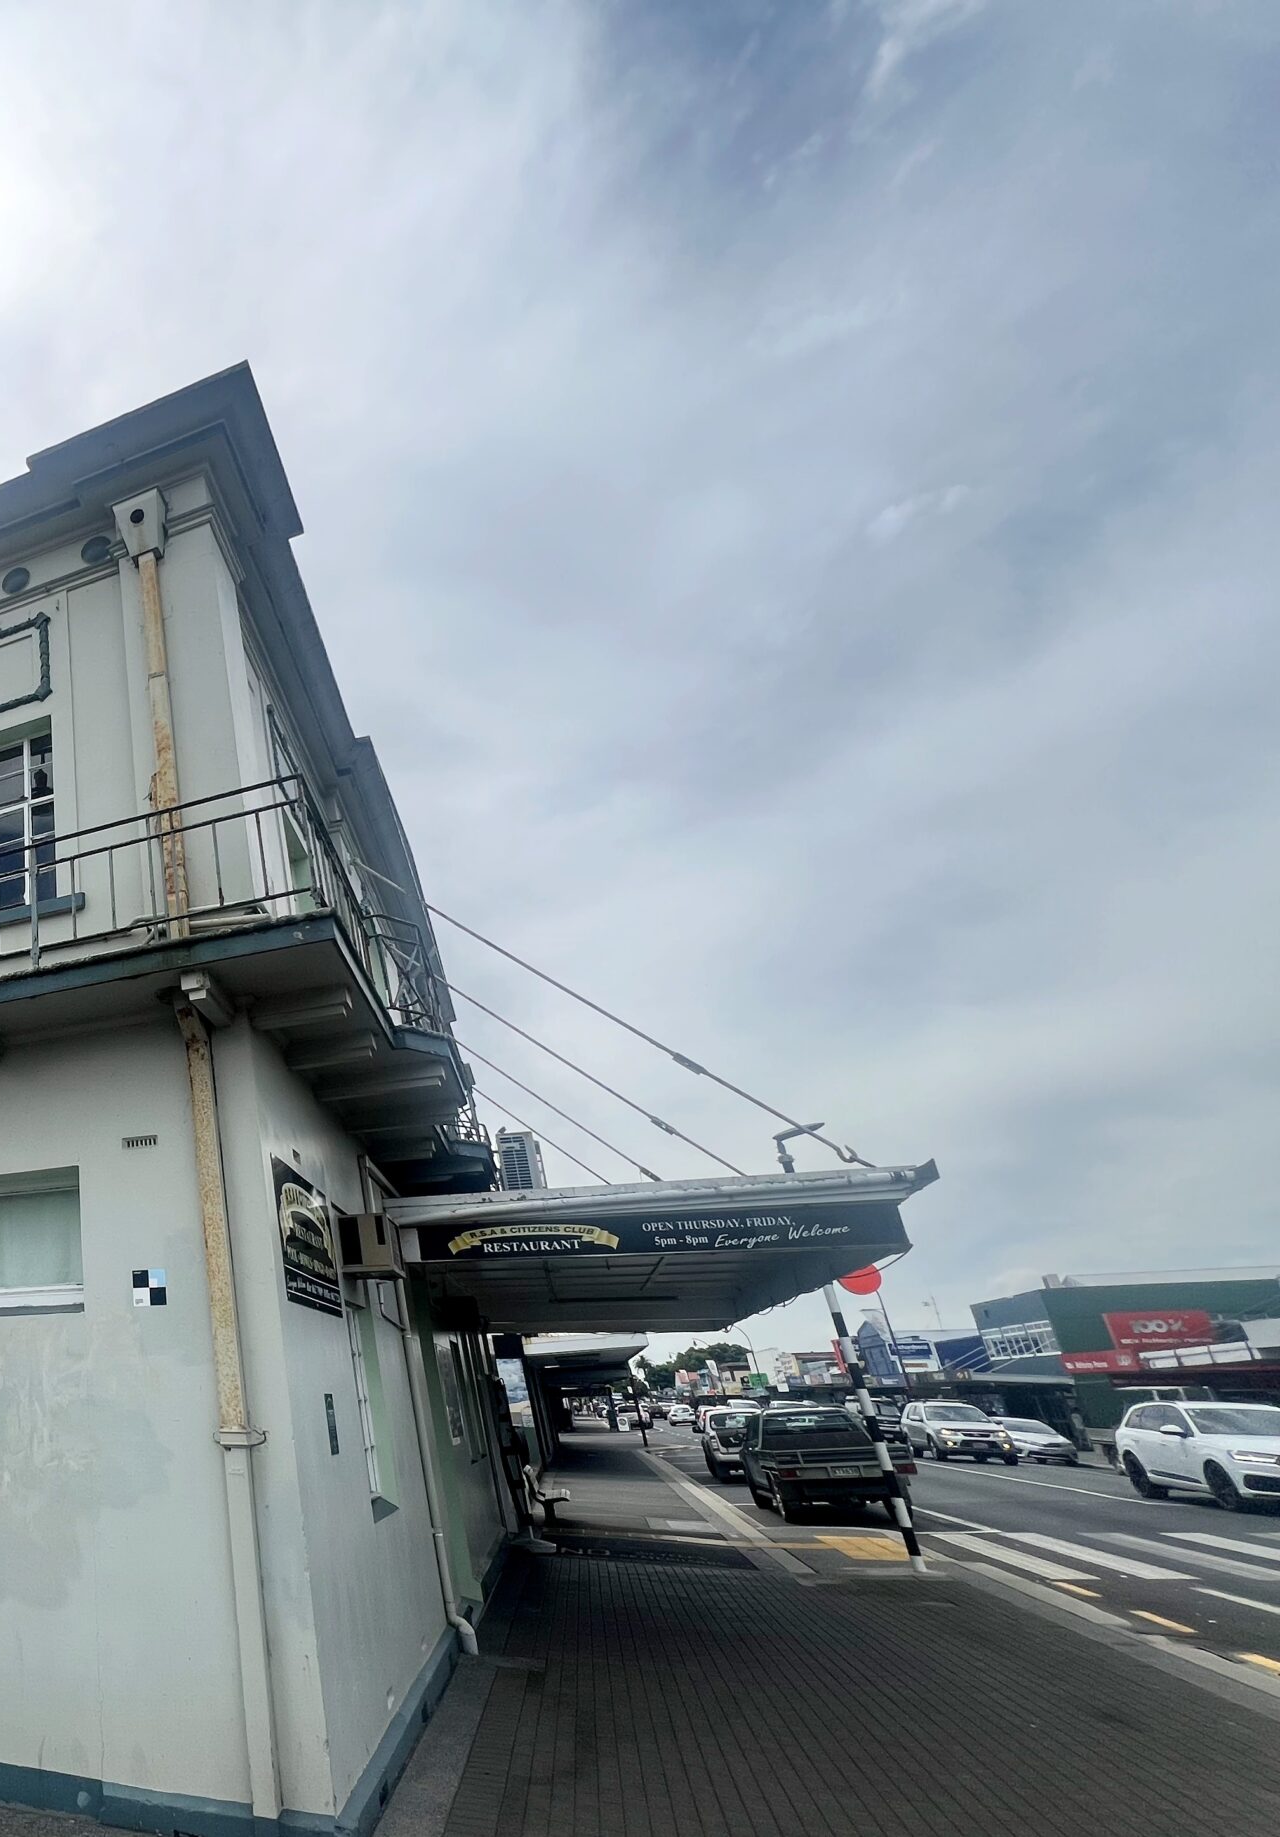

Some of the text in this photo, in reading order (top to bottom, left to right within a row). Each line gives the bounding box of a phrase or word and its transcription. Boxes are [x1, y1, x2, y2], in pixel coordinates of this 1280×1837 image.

[498, 1227, 507, 1236] &
[510, 1224, 561, 1235] CITIZENS
[563, 1225, 595, 1236] CLUB
[642, 1215, 796, 1232] OPEN THURSDAY, FRIDAY,
[654, 1236, 677, 1248] 5pm
[685, 1235, 709, 1247] 8pm
[714, 1223, 851, 1249] Everyone Welcome
[483, 1239, 581, 1253] RESTAURANT
